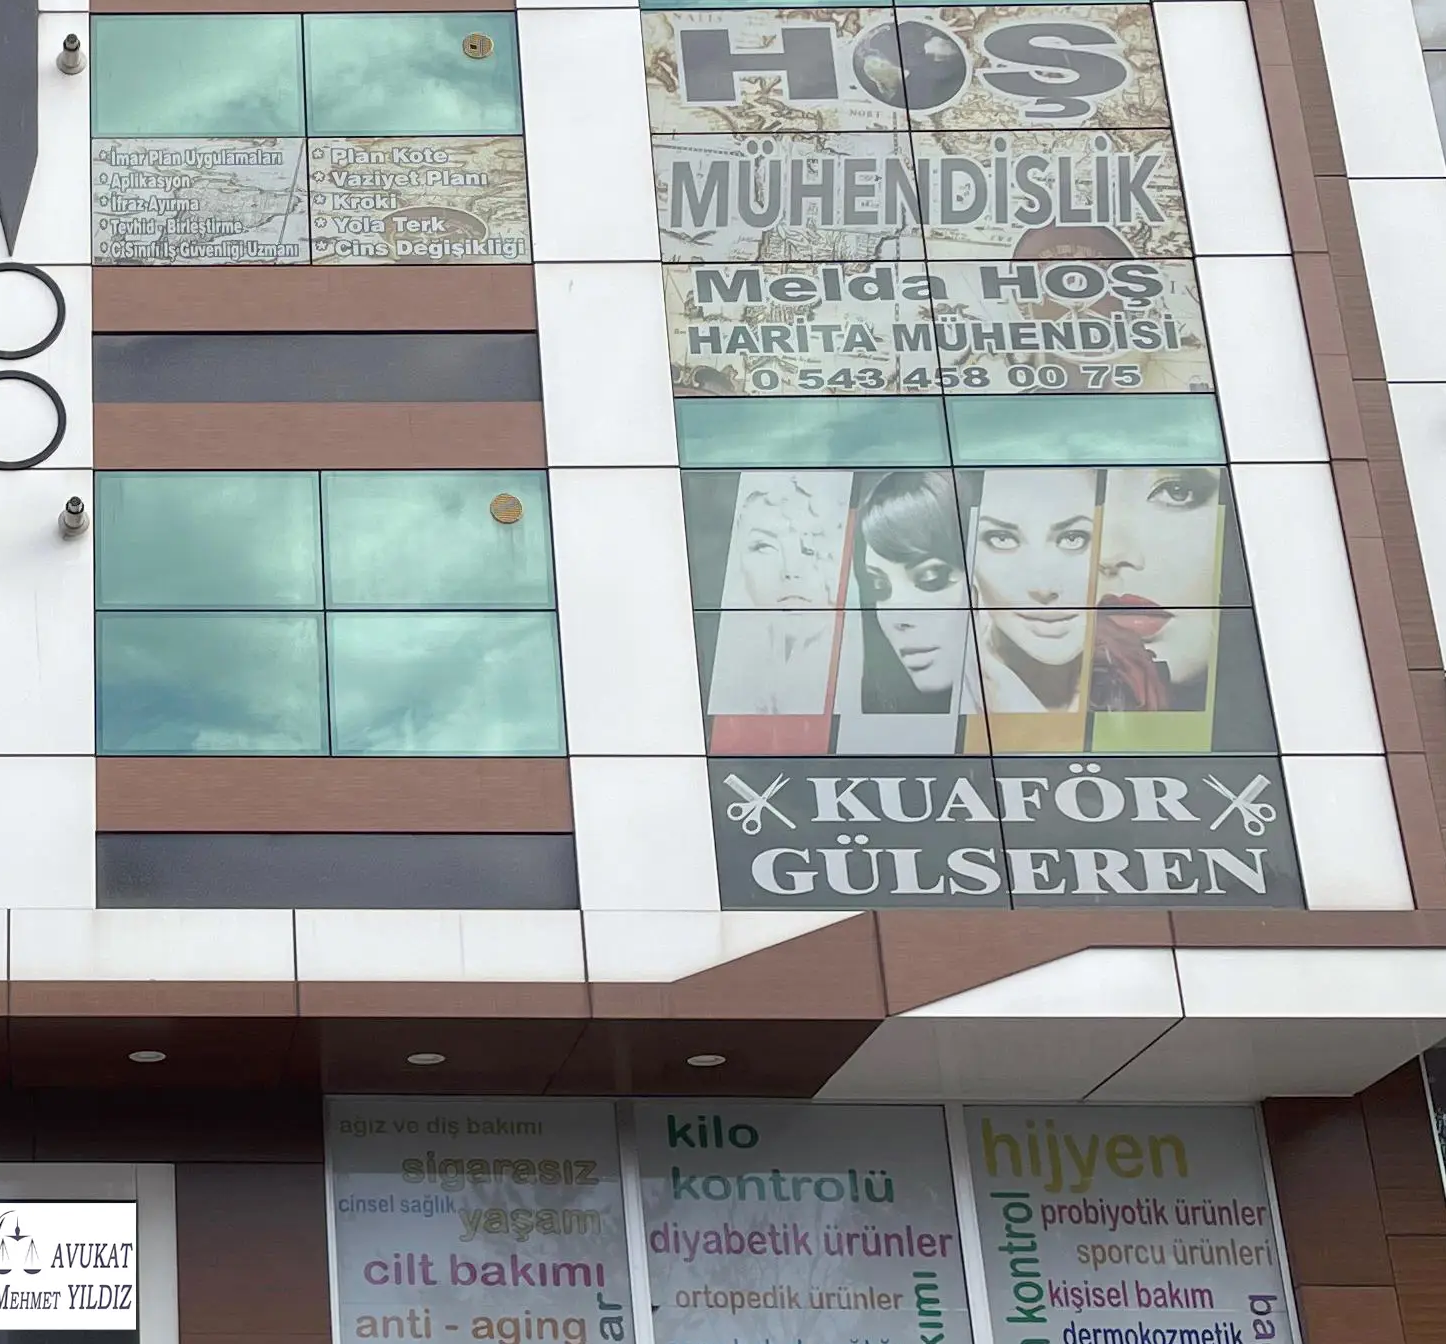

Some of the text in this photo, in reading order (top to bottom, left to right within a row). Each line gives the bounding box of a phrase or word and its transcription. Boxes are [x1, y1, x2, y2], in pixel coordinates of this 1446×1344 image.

[679, 21, 1128, 118] HOŞ
[330, 147, 448, 164] Plan Kote
[110, 174, 191, 190] Aplikasyon
[425, 171, 488, 187] Planı
[671, 135, 1165, 229] MÜHENDİSLİK
[333, 193, 397, 210] Kroki
[333, 217, 445, 234] Yola Terk
[333, 240, 388, 257] Cins
[697, 264, 1163, 307] Melda HOŞ
[688, 315, 1180, 355] HARİTA MÜHENDİSİ
[798, 365, 1141, 389] 543 458 00 75
[806, 763, 1200, 822] KUAFÖR
[753, 835, 1268, 895] GÜLSEREN
[667, 1114, 759, 1149] kilo
[402, 1151, 600, 1191] sigarasız
[982, 1118, 1188, 1193] hijyen
[671, 1167, 894, 1203] kontrolü
[338, 1195, 394, 1214] cinsel
[1041, 1199, 1267, 1231] probiyotik ürünler
[459, 1208, 602, 1242] yaşam
[51, 1243, 133, 1268] AVUKAT
[649, 1223, 953, 1262] diyabetik ürünler
[990, 1192, 1050, 1323] kontrol
[1077, 1239, 1273, 1269] sporcu ürünleri
[364, 1253, 604, 1287] cilt bakımı
[68, 1285, 132, 1309] YILDIZ
[675, 1284, 903, 1315] ortopedik ürünler
[1047, 1279, 1214, 1313] kişisel bakım
[356, 1309, 432, 1338] anti
